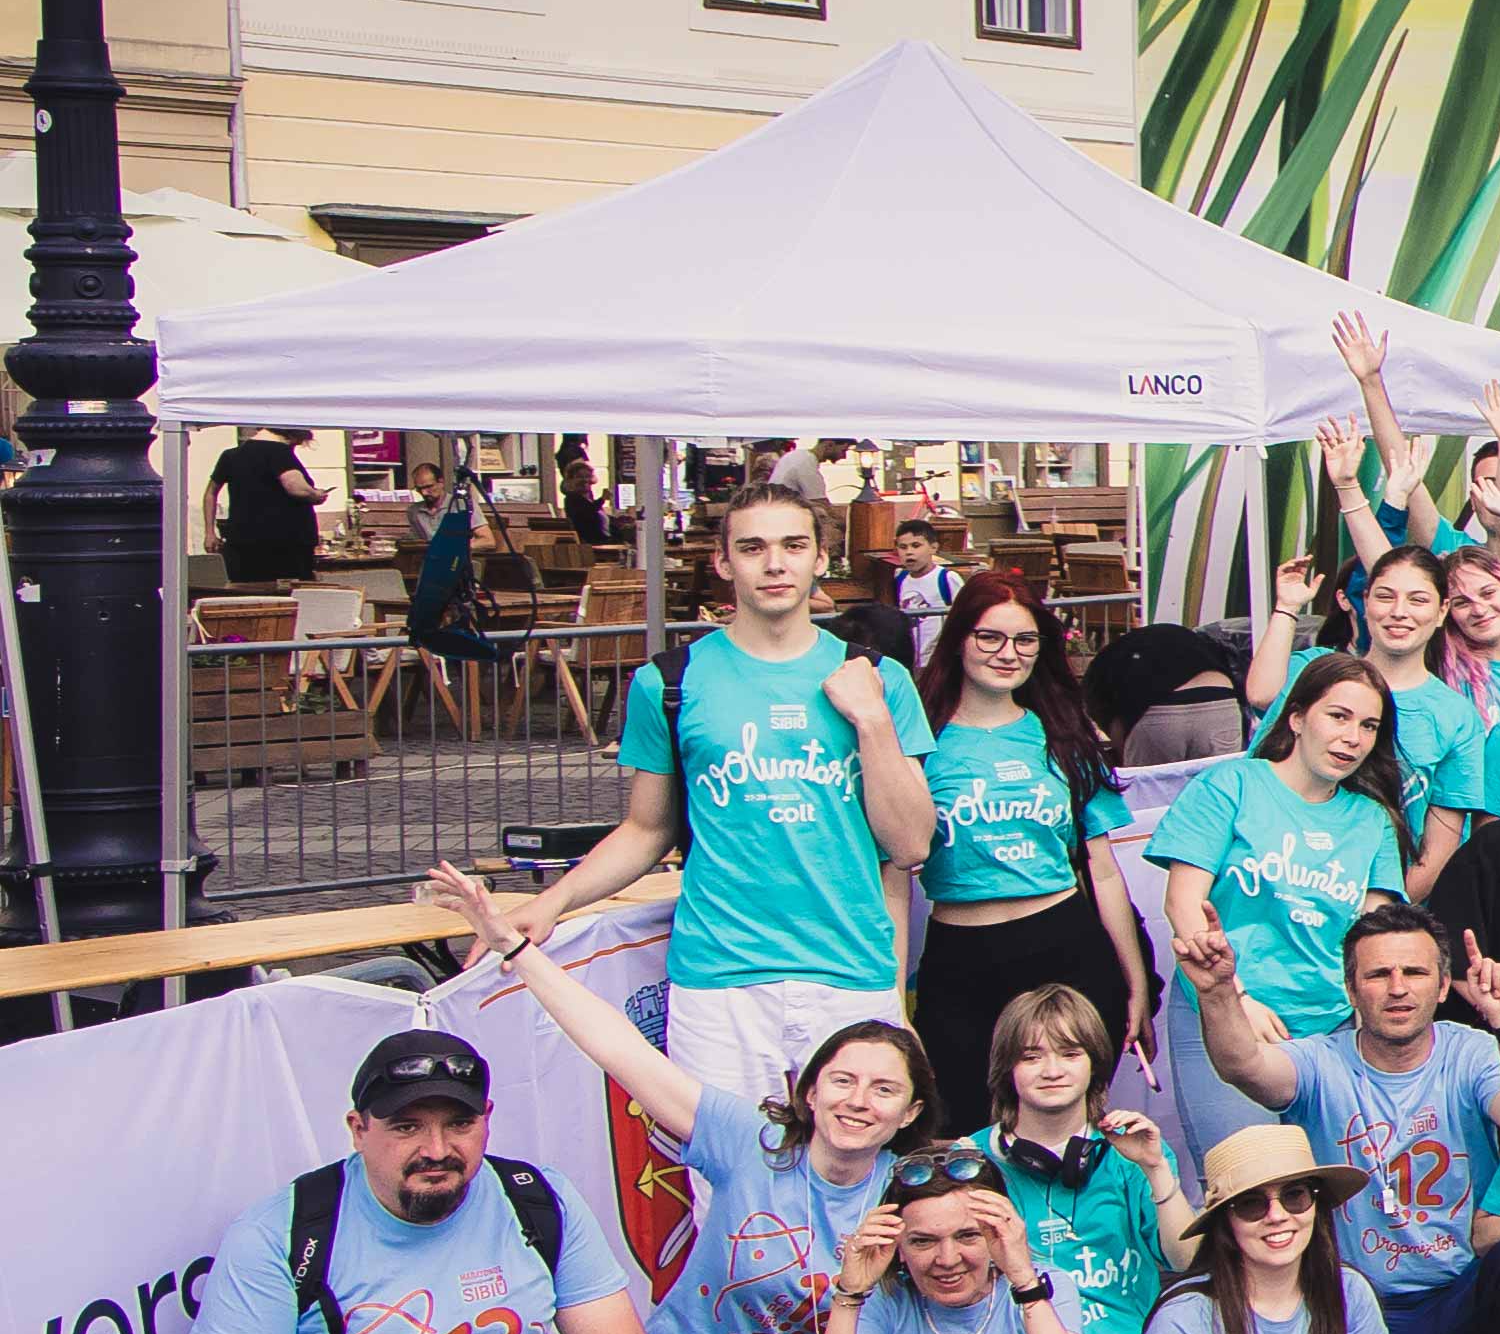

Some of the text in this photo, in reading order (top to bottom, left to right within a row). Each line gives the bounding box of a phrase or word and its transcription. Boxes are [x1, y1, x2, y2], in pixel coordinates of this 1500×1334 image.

[1128, 374, 1203, 395] LANCO
[768, 803, 817, 824] colt
[994, 842, 1037, 862] colt
[462, 1275, 509, 1303] SIBIU
